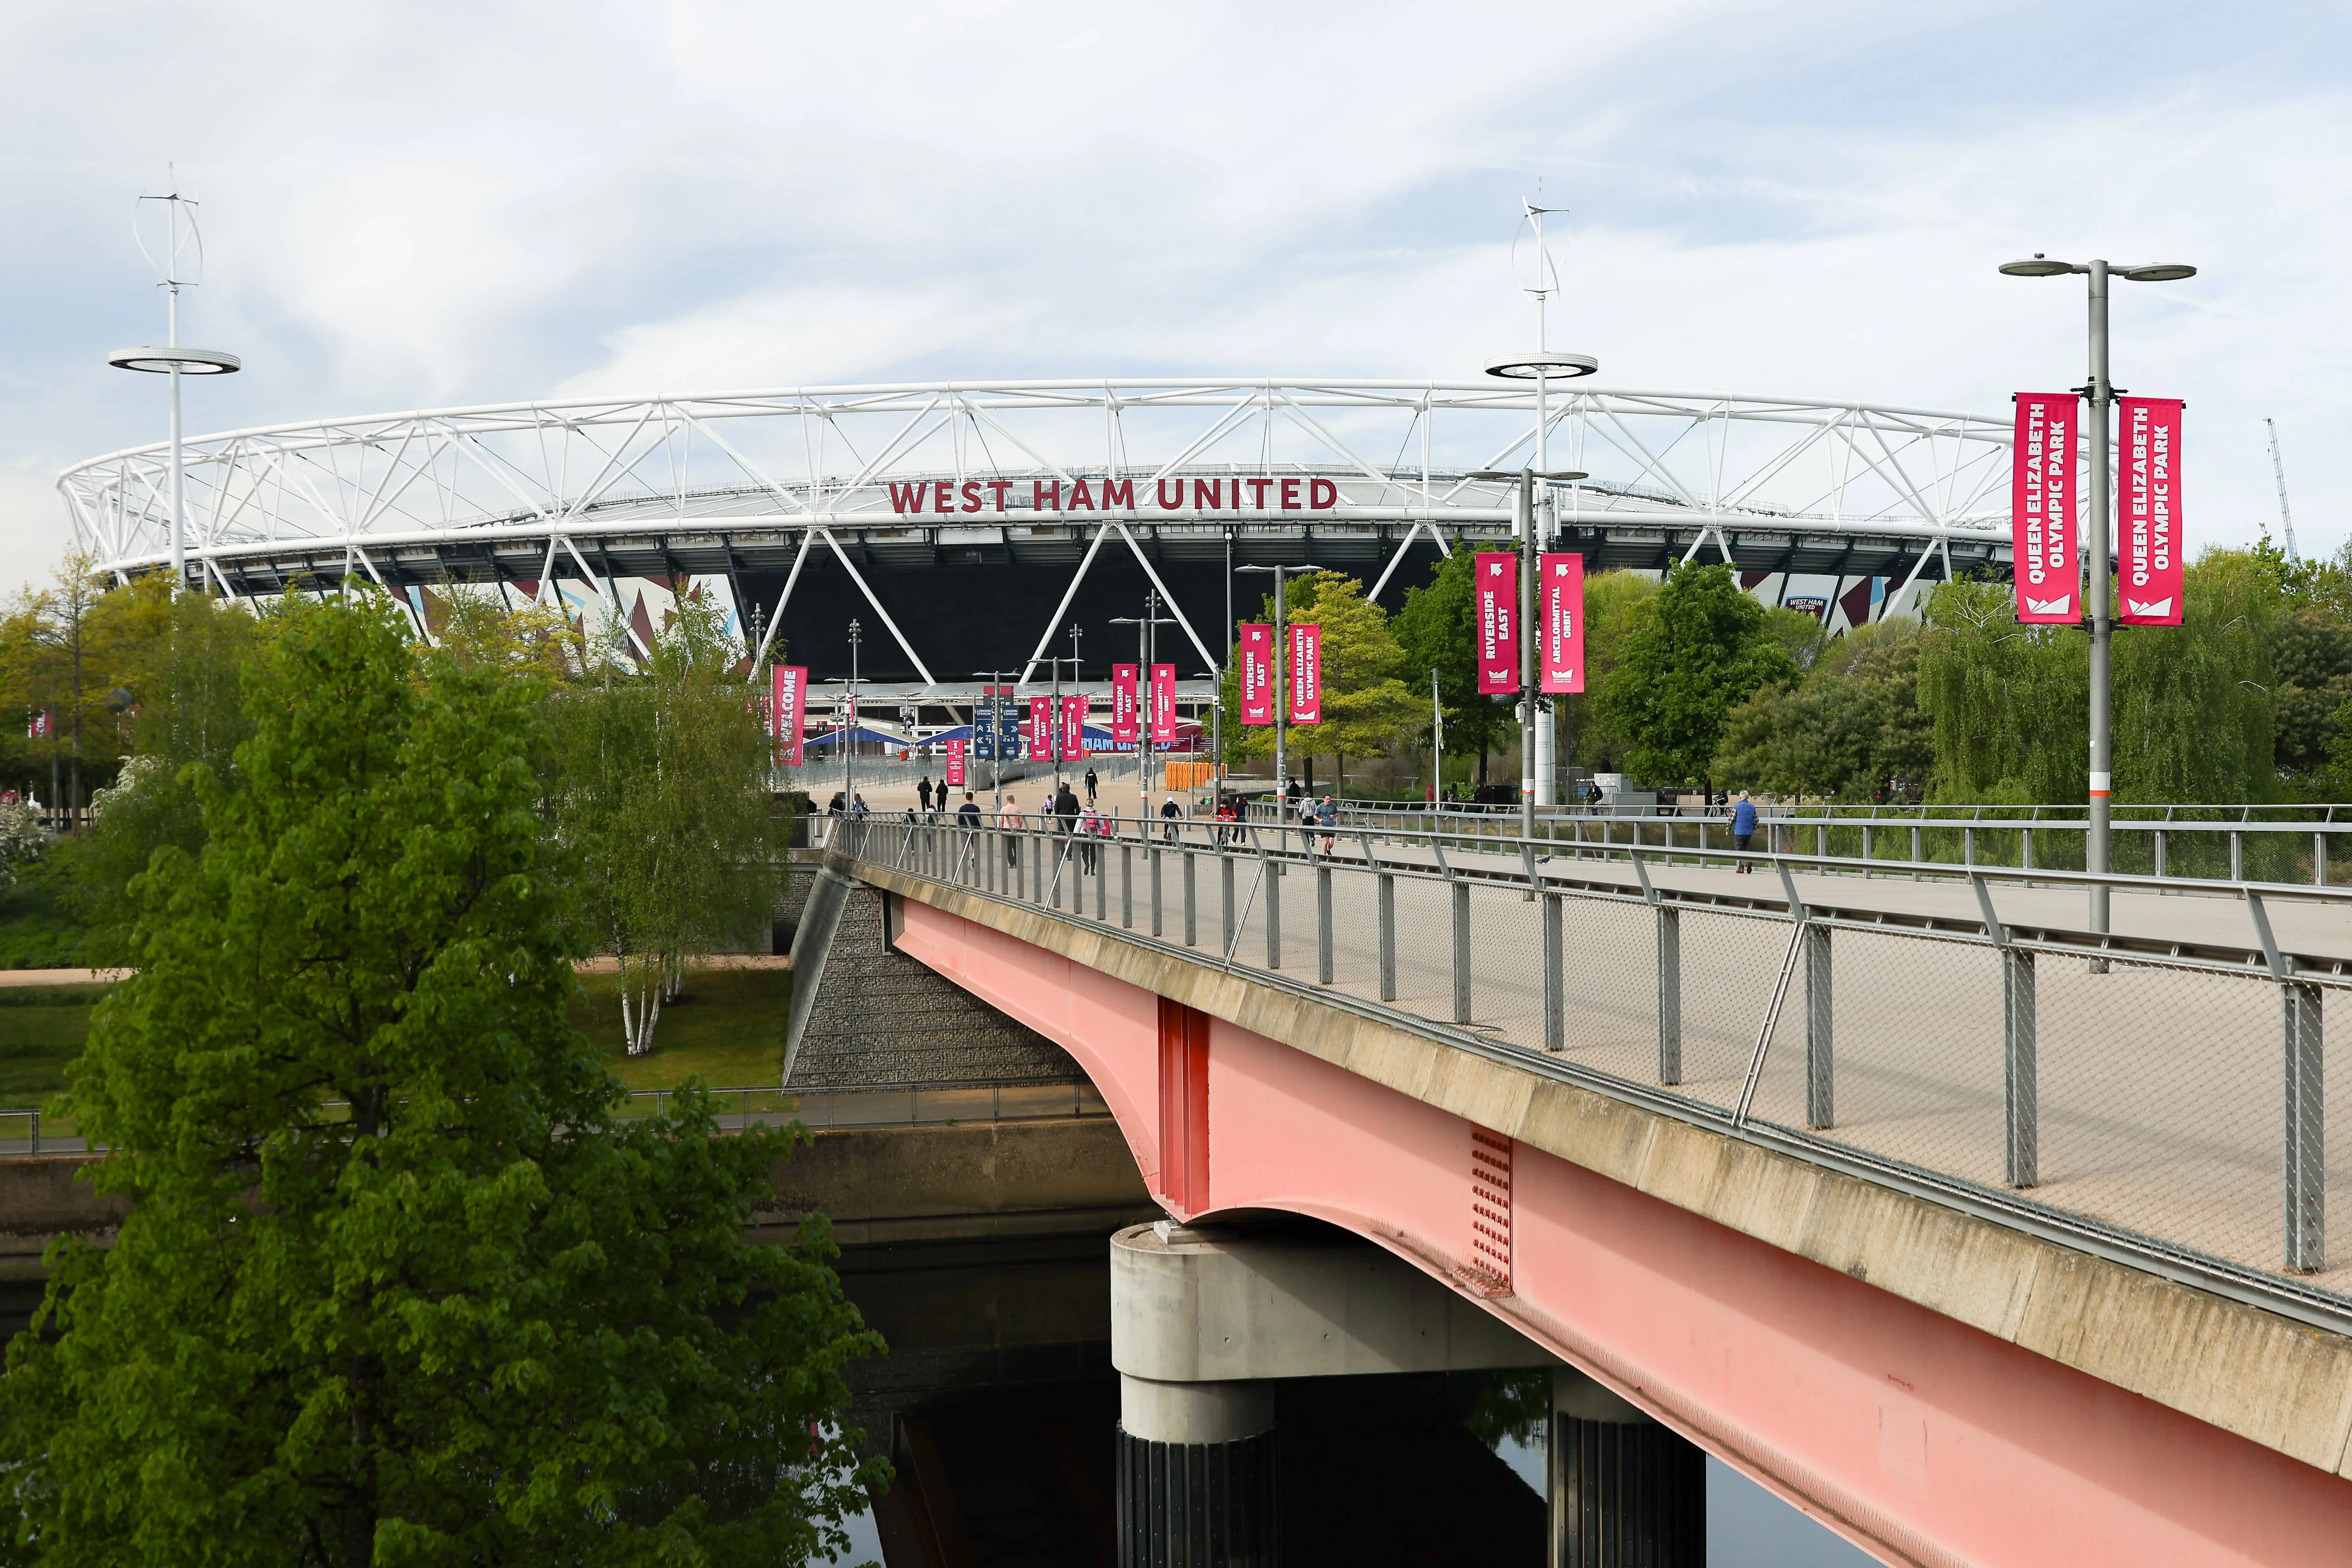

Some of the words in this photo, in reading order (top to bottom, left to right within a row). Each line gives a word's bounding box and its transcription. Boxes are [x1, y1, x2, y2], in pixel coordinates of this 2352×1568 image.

[2027, 404, 2044, 513] ELIZABETH
[2048, 420, 2065, 476] PARK
[2133, 407, 2148, 515] ELIZABETH
[2153, 425, 2168, 480] PARK
[889, 481, 1012, 513] WEST
[1033, 479, 1134, 511] HAM
[1158, 478, 1338, 510] UNITED
[2026, 517, 2046, 584] QUEEN
[2048, 480, 2064, 568] OLYMPIC
[2153, 484, 2169, 570] OLYMPIC
[2132, 520, 2149, 586] QUEEN
[1306, 636, 1315, 659] PARK
[1483, 590, 1496, 660] RIVERSIDE
[1498, 607, 1509, 640] EAST
[1551, 586, 1562, 664] ARCELORMITTAL
[1563, 609, 1572, 639] ORBIT
[1246, 651, 1255, 701] RIVERSIDE
[1257, 663, 1266, 687] EAST
[1296, 629, 1304, 676] ELIZABETH
[780, 670, 796, 742] WELCOME
[1296, 677, 1305, 707] QUEEN
[1306, 661, 1314, 700] OLYMPIC
